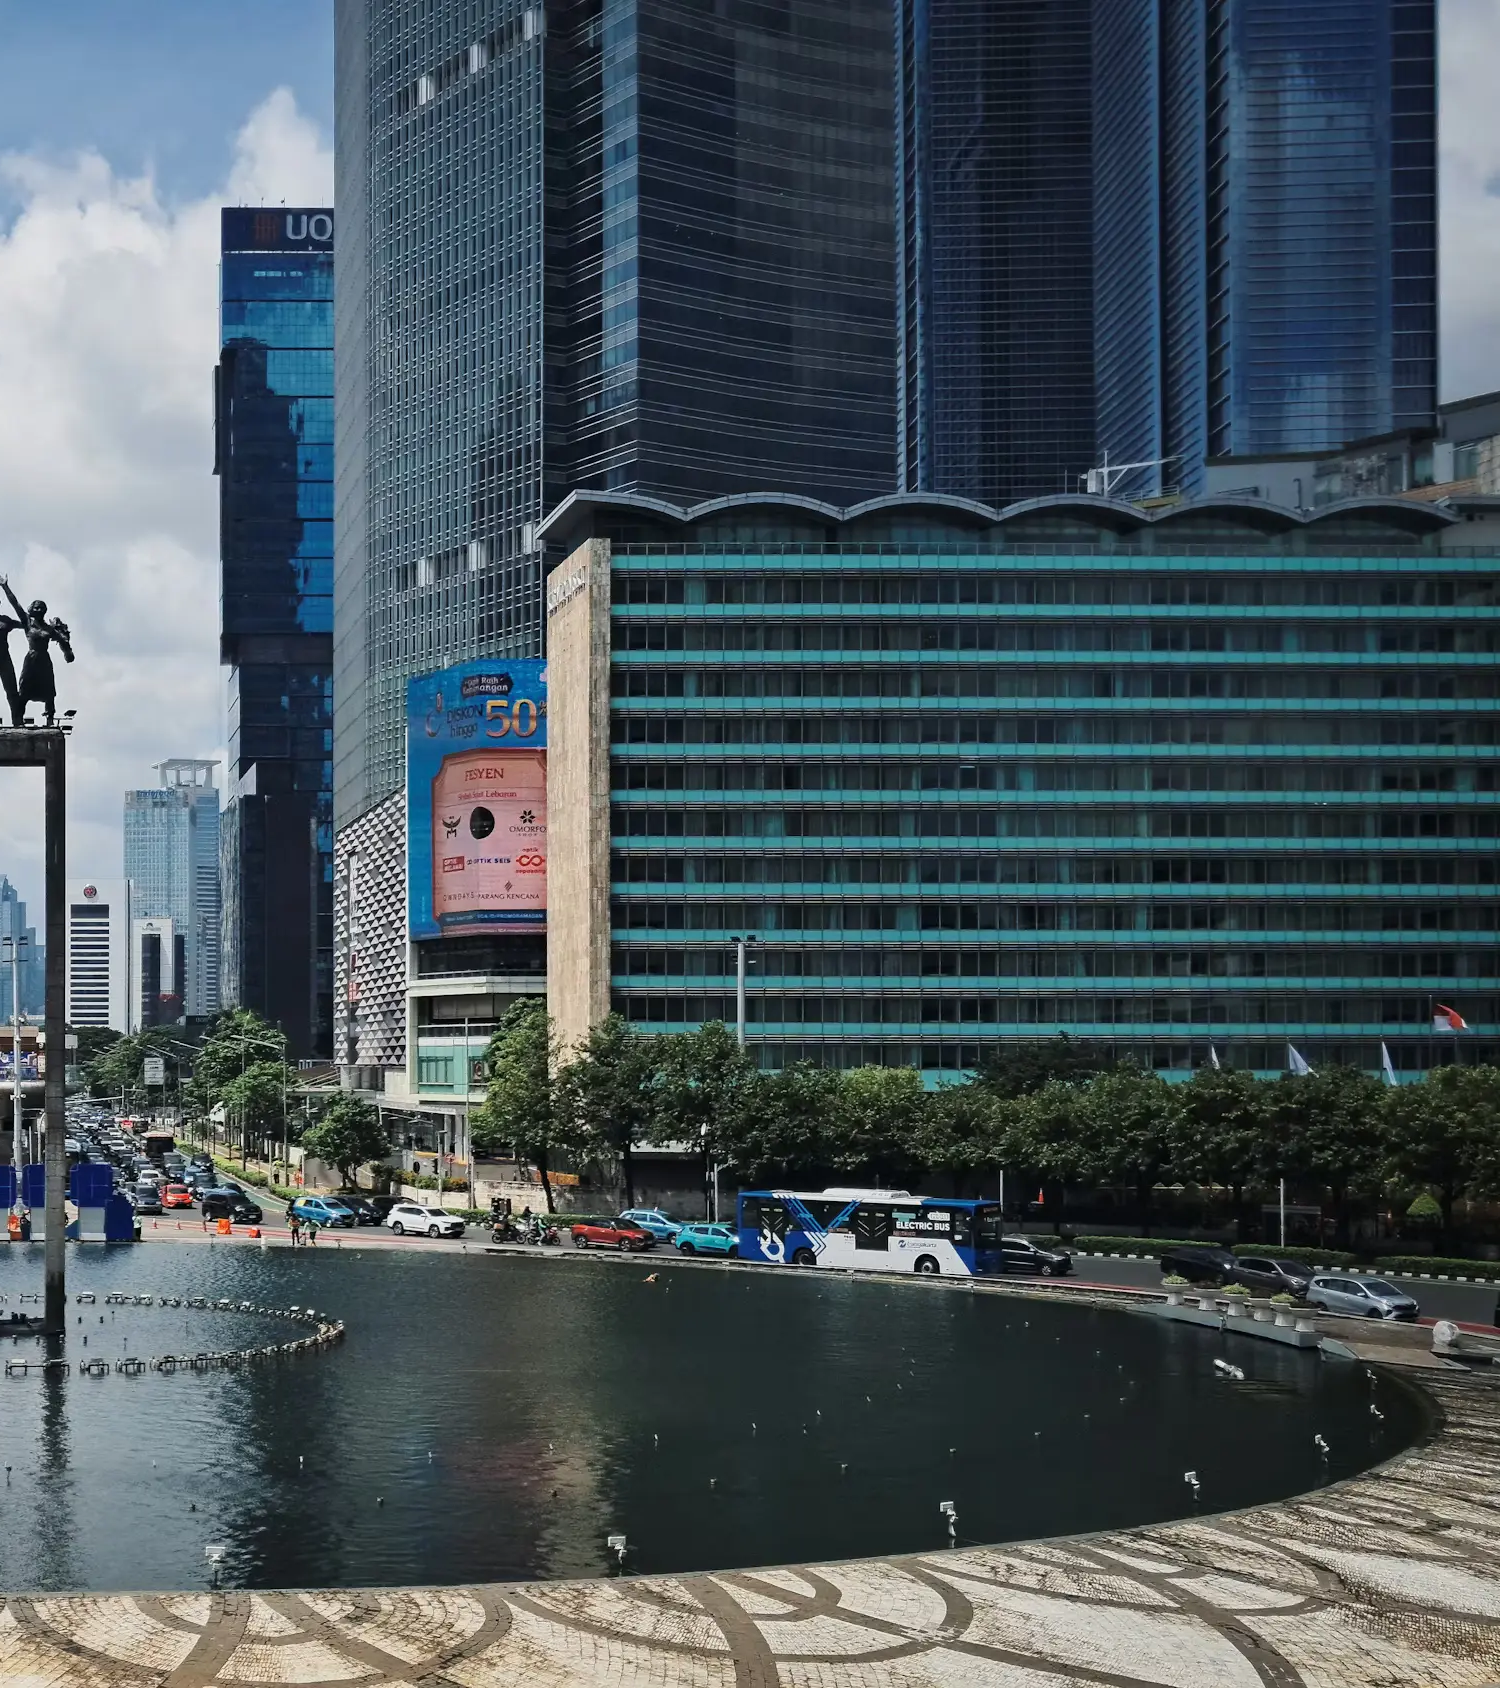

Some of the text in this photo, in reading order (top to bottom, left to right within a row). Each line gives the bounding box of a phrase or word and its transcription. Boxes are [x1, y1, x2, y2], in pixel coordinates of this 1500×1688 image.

[286, 214, 333, 240] UO
[465, 768, 504, 781] FESYEN
[896, 1221, 951, 1231] ELECTRIC BUS
